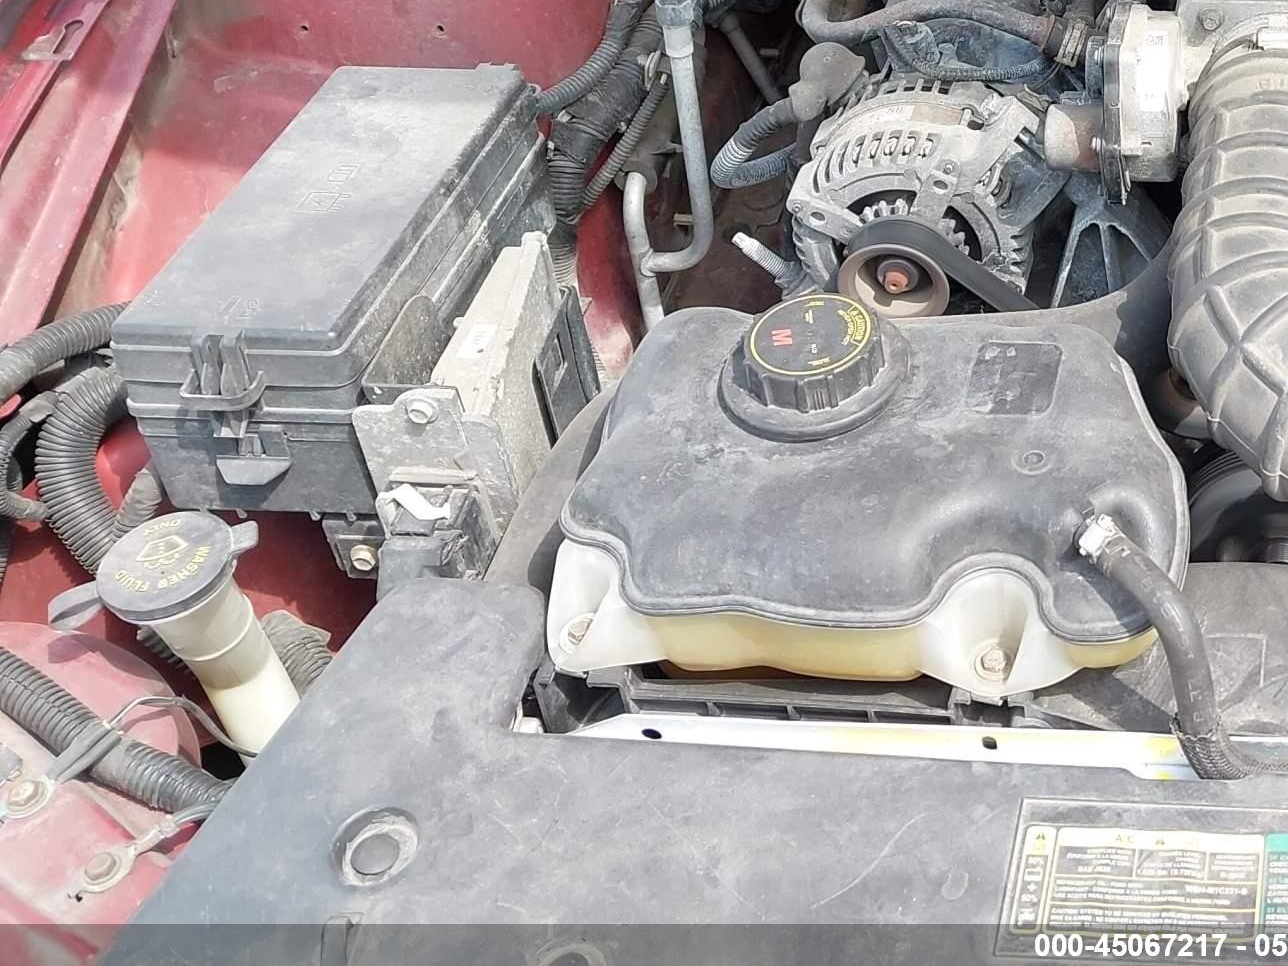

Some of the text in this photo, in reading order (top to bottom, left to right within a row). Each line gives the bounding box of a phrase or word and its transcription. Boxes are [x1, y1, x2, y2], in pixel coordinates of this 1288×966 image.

[143, 519, 184, 536] ONLY
[115, 545, 212, 593] WASHER FLUID
